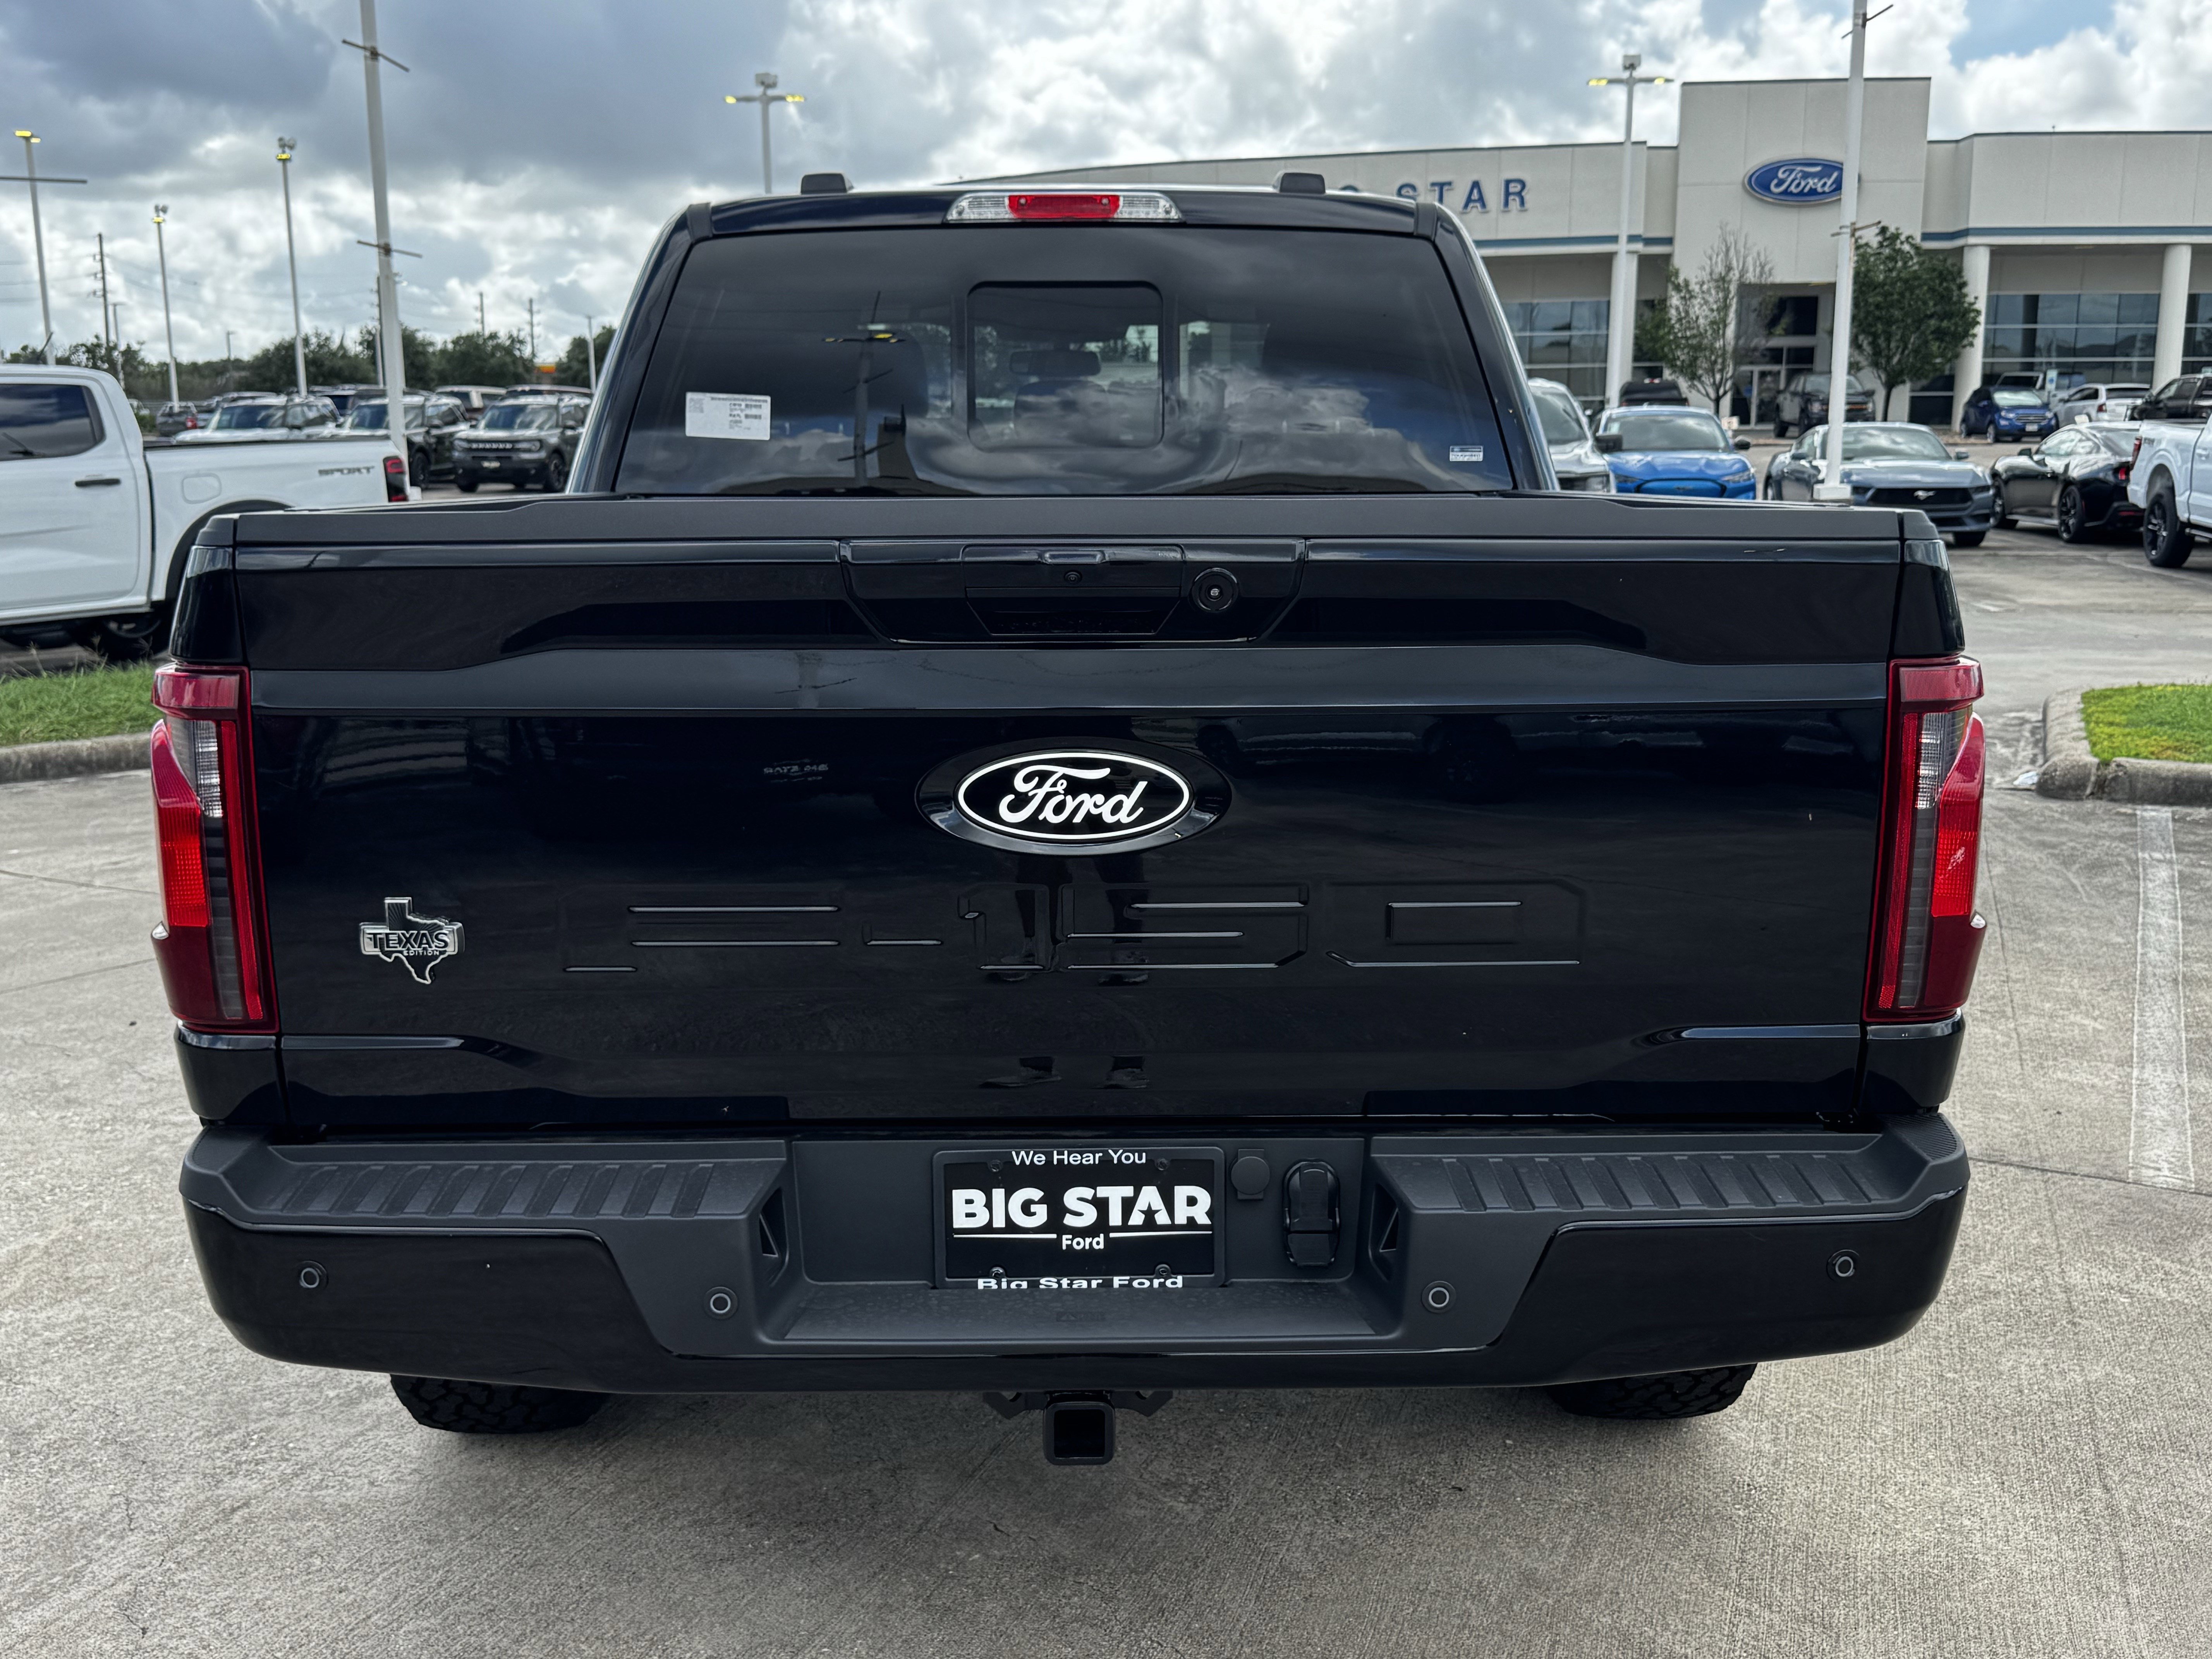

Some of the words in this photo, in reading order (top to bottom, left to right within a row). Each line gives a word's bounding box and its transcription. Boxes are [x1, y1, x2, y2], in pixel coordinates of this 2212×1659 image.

[1770, 165, 1840, 194] Ford
[1396, 178, 1528, 212] STAR
[999, 764, 1147, 824] Ford
[366, 930, 450, 951] TEXAS
[1012, 1150, 1046, 1165] We
[1053, 1149, 1103, 1164] Hear
[1108, 1149, 1146, 1164] You
[952, 1187, 1048, 1228] BIG
[1063, 1185, 1212, 1227] STAR
[1062, 1233, 1104, 1250] Ford
[977, 1278, 1027, 1290] Big
[1039, 1277, 1103, 1289] Star
[1113, 1275, 1183, 1288] Ford
